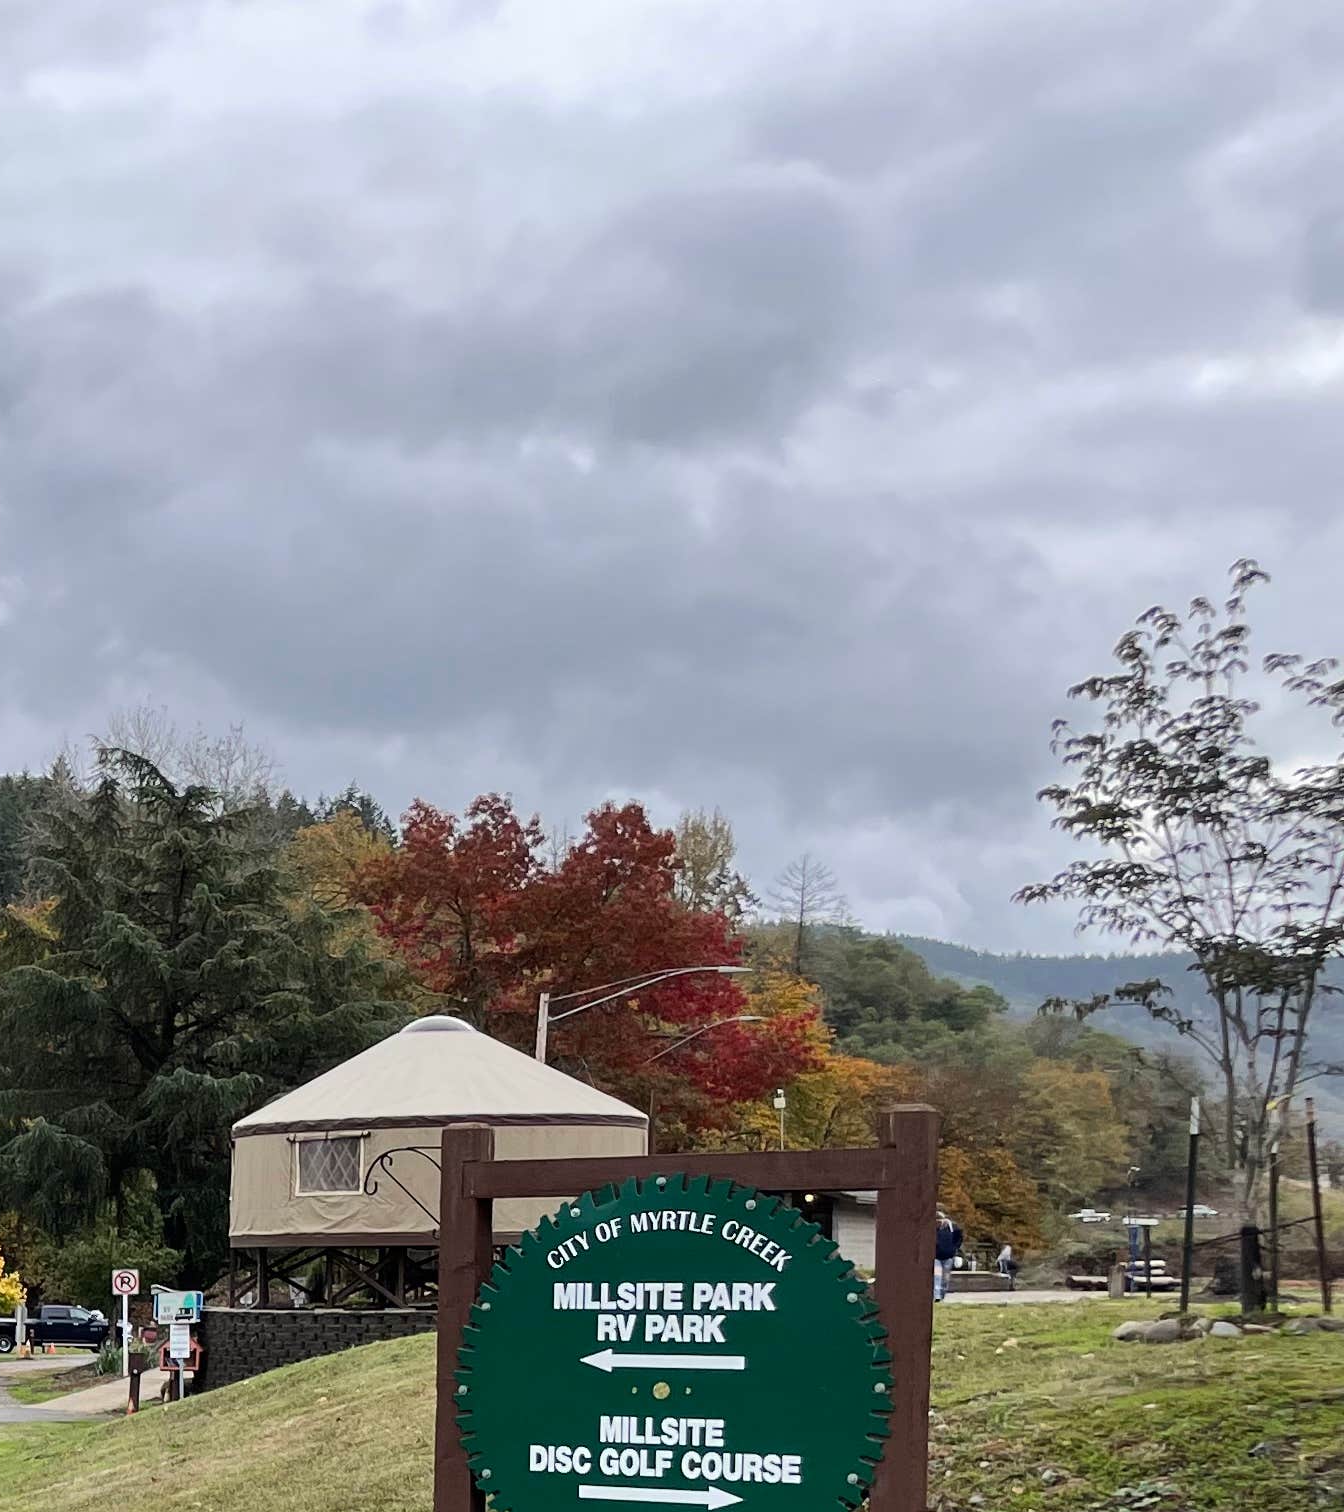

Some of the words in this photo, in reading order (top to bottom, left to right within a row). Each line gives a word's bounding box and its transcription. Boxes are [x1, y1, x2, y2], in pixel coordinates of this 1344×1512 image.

[546, 1231, 590, 1269] CITY
[595, 1217, 623, 1242] OF
[630, 1210, 717, 1235] MYRTLE
[721, 1220, 793, 1272] CREEK
[553, 1282, 684, 1310] MILLSITE
[693, 1282, 777, 1311] PARK
[597, 1314, 637, 1341] RV
[645, 1314, 727, 1342] PARK
[599, 1415, 725, 1447] MILLSITE
[529, 1444, 592, 1474] DISC
[599, 1448, 674, 1477] GOLF
[681, 1451, 802, 1484] COURSE
